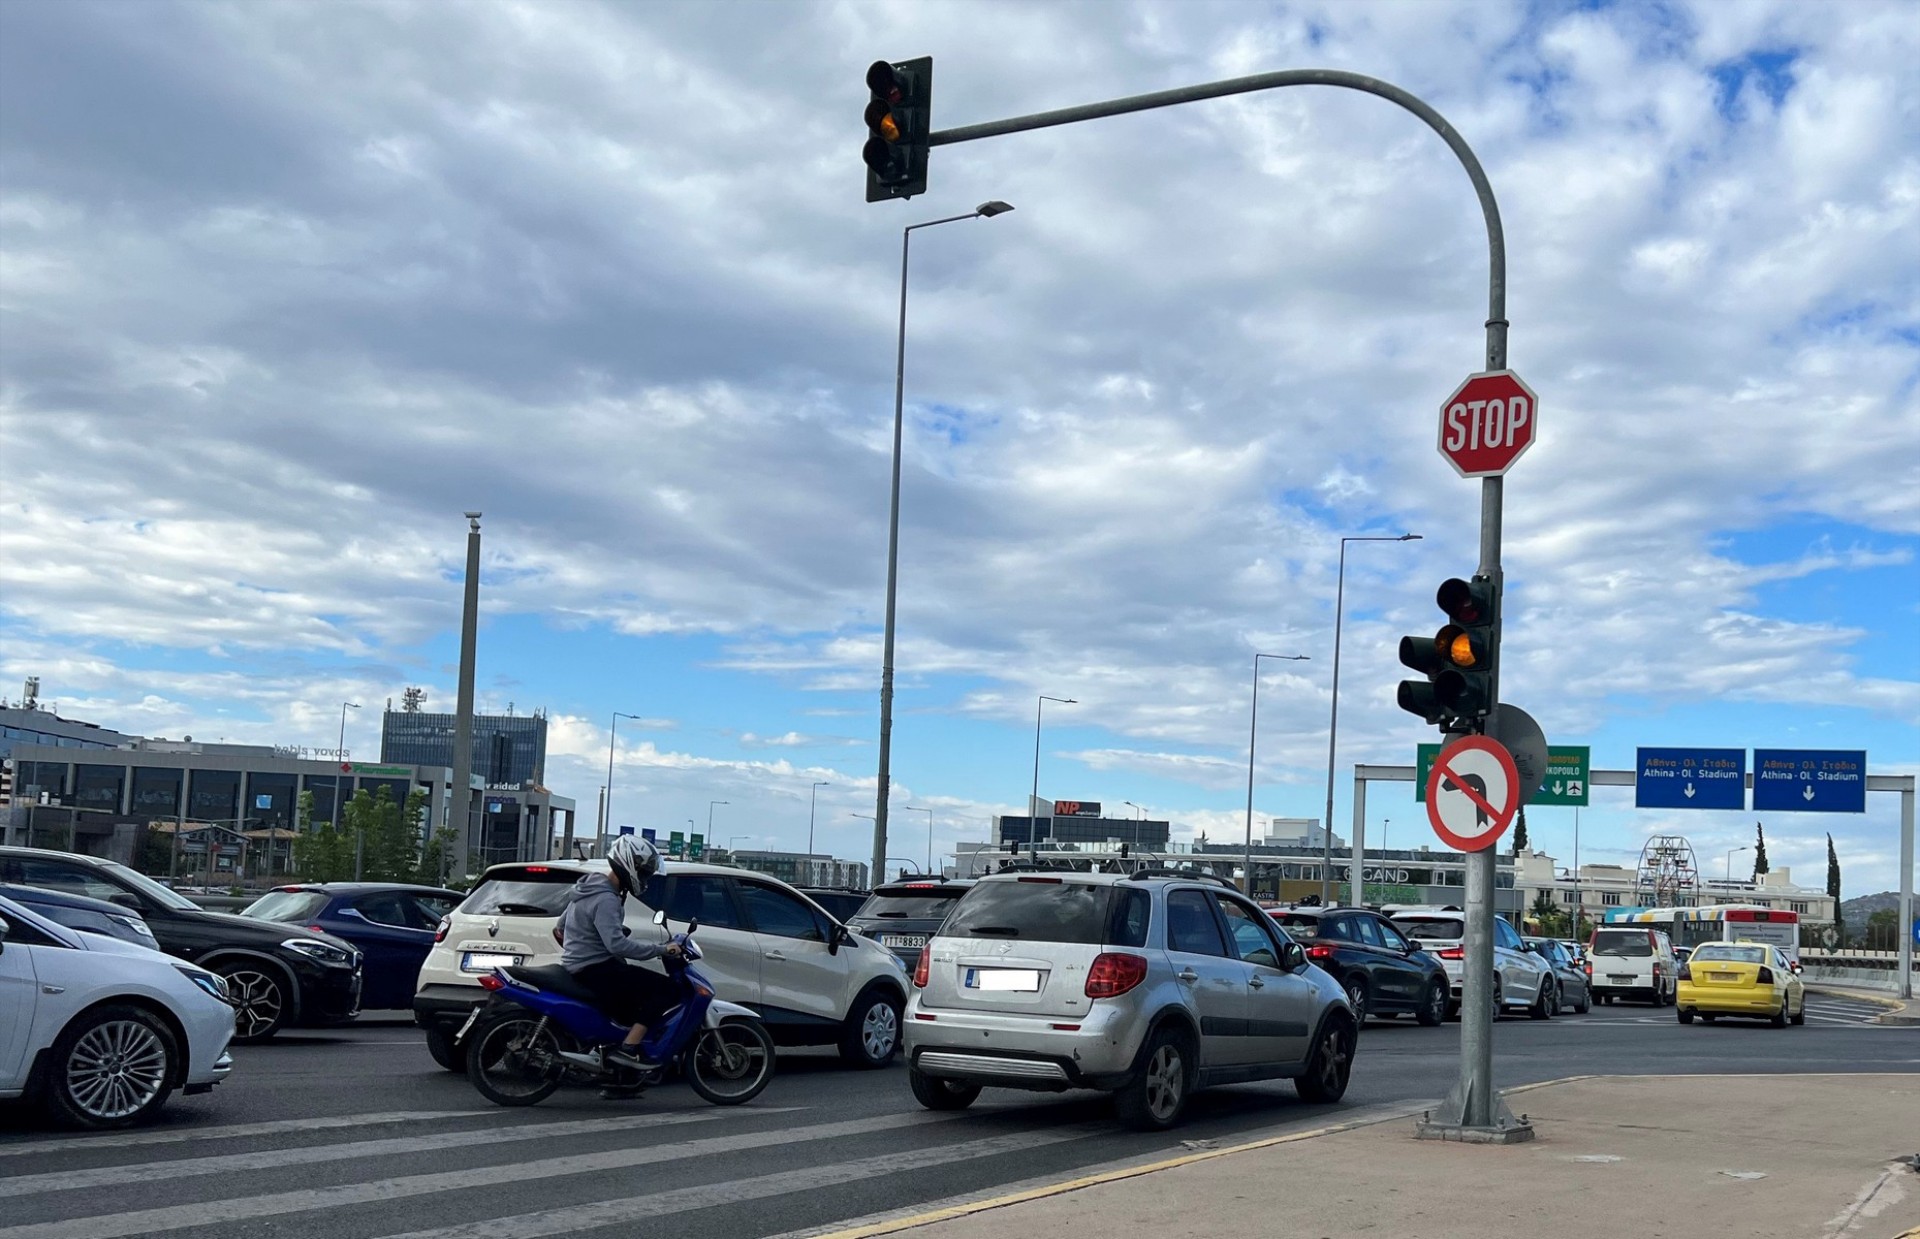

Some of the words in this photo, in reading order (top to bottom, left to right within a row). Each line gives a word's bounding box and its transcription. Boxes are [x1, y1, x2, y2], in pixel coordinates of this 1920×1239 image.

[1446, 396, 1528, 452] STOP
[1643, 768, 1675, 777] Athina
[1698, 769, 1738, 779] Stadium
[1761, 771, 1793, 780] Athina
[1817, 771, 1858, 781] Stadium
[1055, 801, 1080, 815] NP
